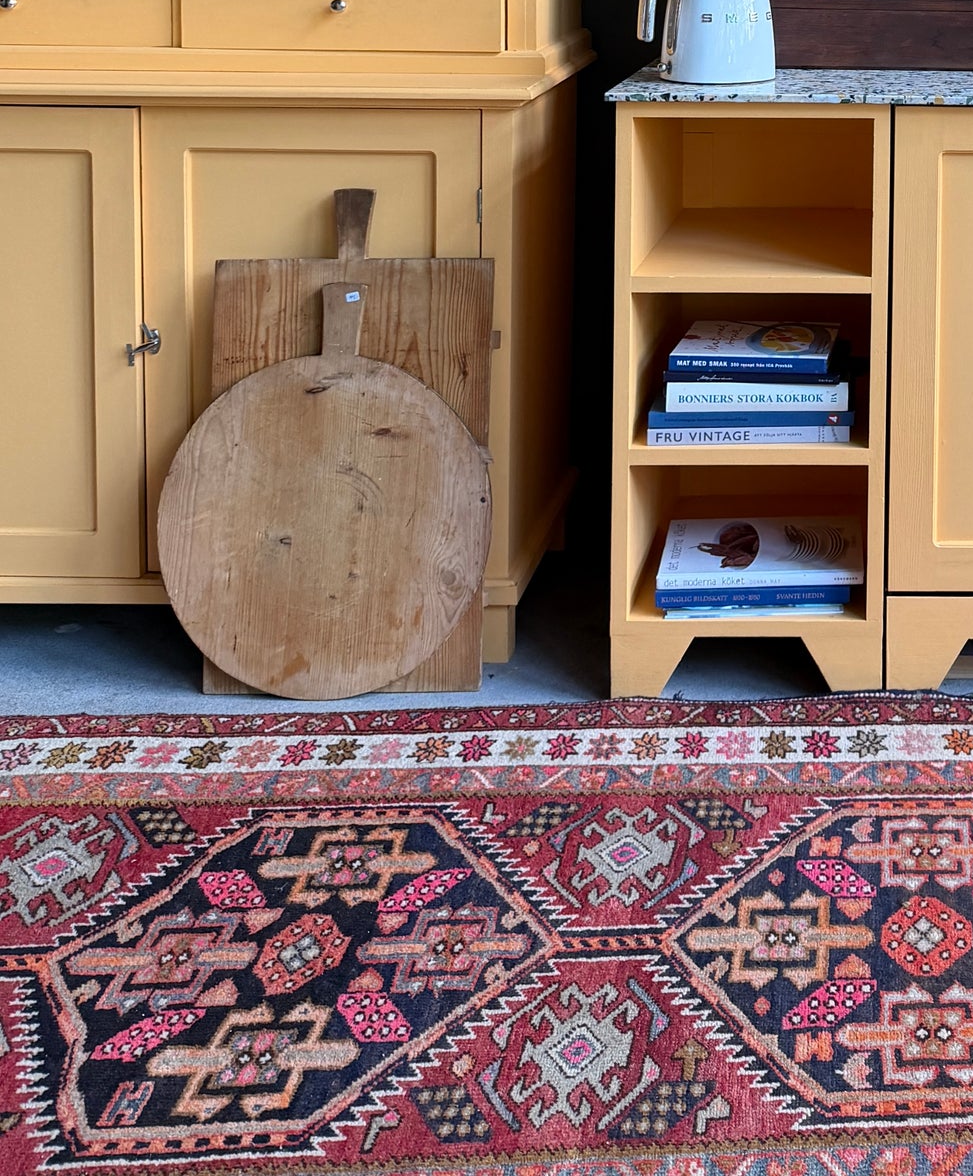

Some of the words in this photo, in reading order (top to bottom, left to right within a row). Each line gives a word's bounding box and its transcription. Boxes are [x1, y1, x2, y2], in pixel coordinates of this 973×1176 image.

[678, 394, 733, 404] BONNIERS
[737, 394, 773, 403] STORA
[776, 393, 823, 403] KOKBOK
[655, 432, 683, 443] FRU
[689, 430, 751, 442] VINTAGE
[663, 579, 679, 587] det
[683, 578, 717, 587] moderna
[721, 576, 746, 586] köket
